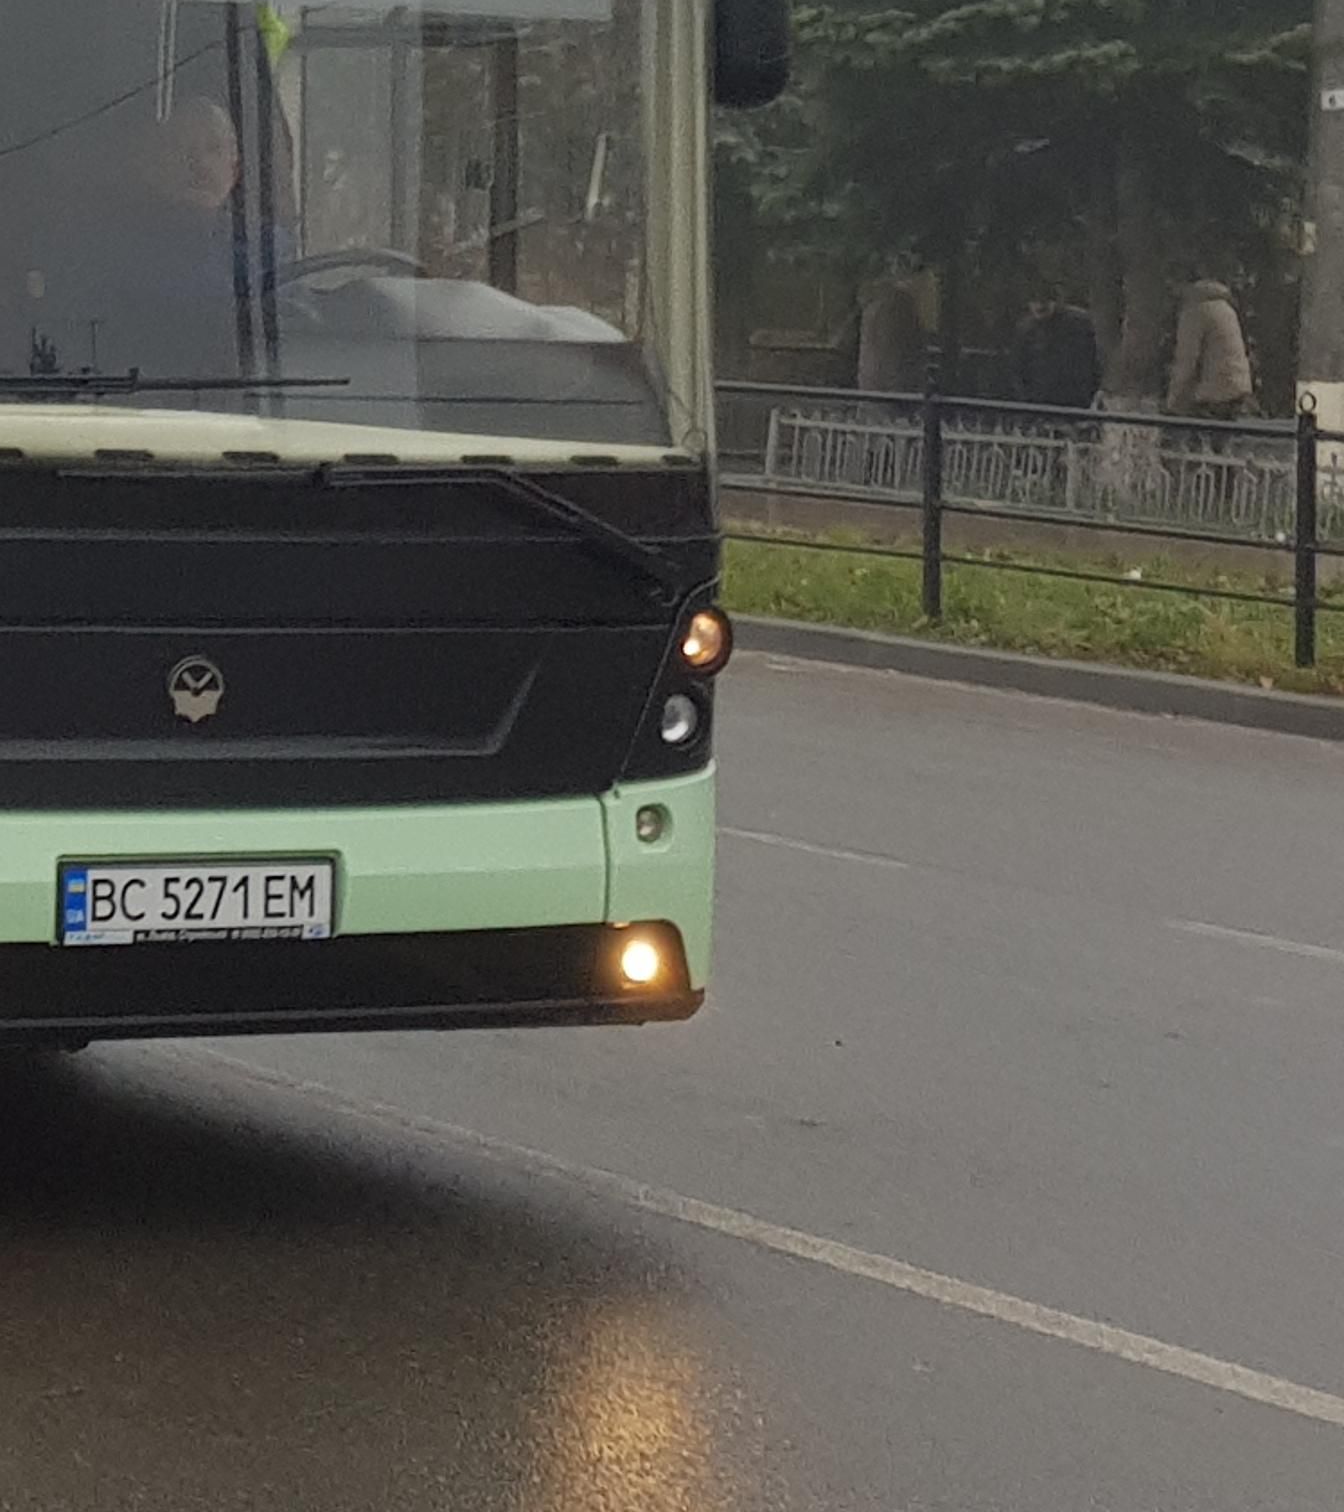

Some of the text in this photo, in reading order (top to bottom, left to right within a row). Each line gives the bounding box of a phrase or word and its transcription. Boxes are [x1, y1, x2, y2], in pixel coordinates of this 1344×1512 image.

[91, 874, 315, 923] BC 5271 EM
